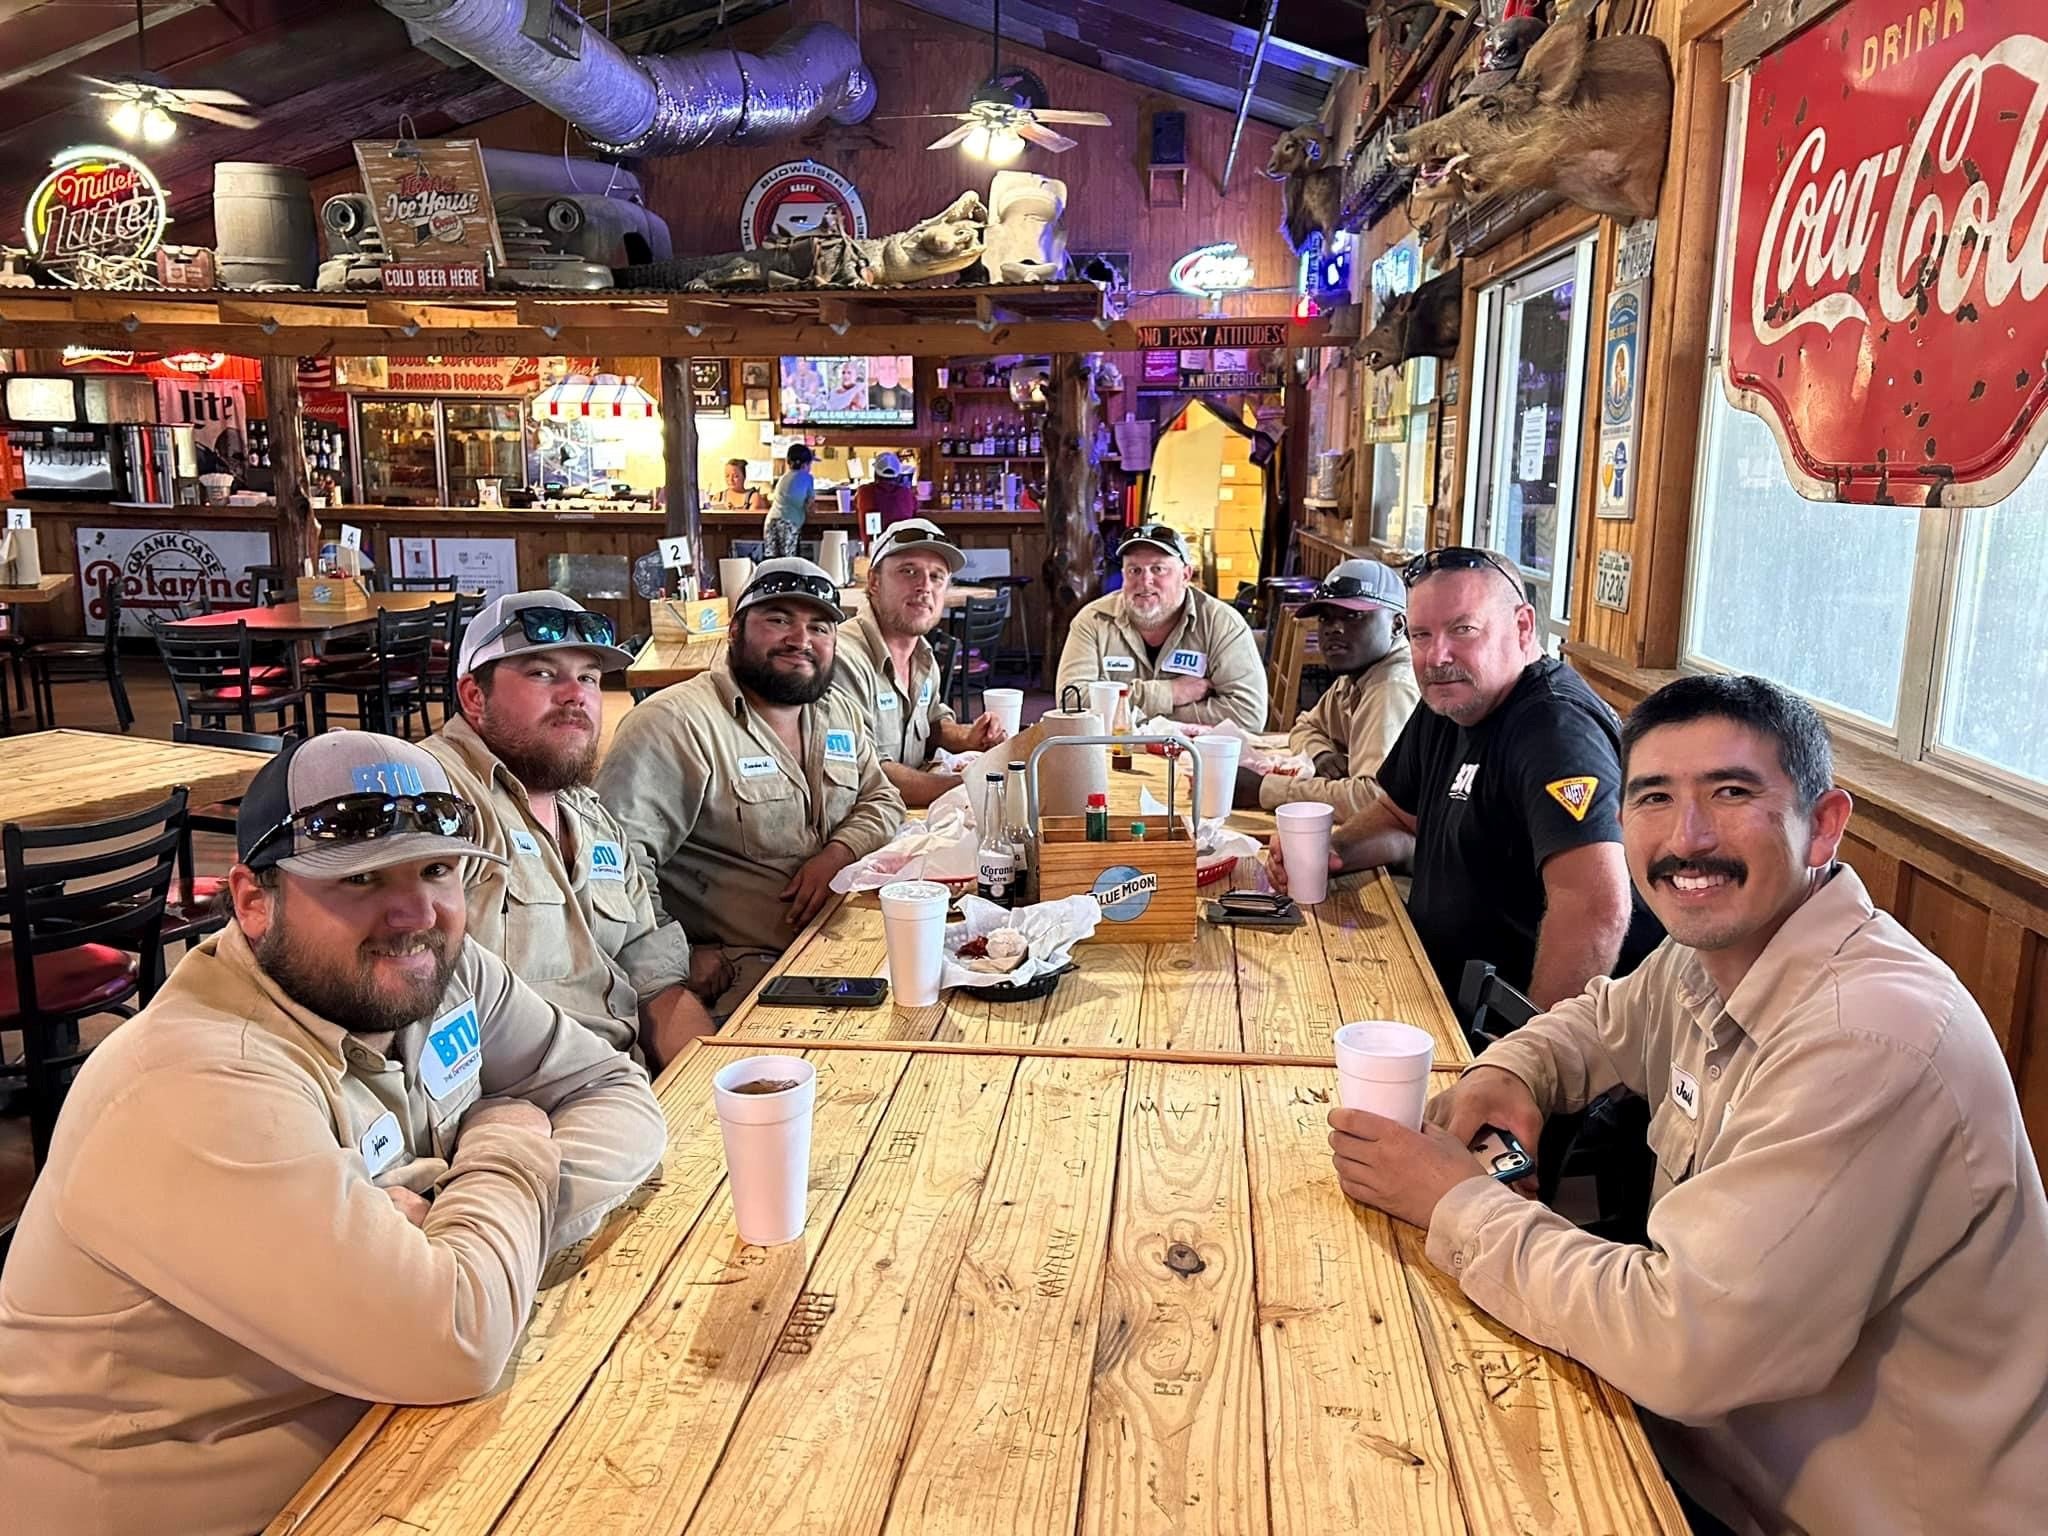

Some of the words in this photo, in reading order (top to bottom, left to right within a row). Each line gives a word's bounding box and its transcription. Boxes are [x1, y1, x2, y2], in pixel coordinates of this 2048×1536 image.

[1860, 0, 1965, 80] DRINK
[759, 164, 845, 190] BUDWEISER
[57, 170, 140, 207] Miller
[384, 269, 415, 288] COLD
[417, 269, 447, 288] BEER
[449, 267, 480, 287] HERE
[1145, 327, 1162, 346] NO
[1169, 327, 1207, 346] PISSY
[1213, 325, 1280, 345] ATTITUDES
[405, 372, 452, 390] ARMED
[453, 373, 504, 391] FORCES
[347, 532, 355, 546] 4
[127, 535, 178, 575] CRANK
[181, 538, 221, 577] CASE
[670, 545, 681, 561] 2
[1173, 652, 1198, 668] BTU
[826, 734, 852, 753] BTU
[352, 762, 425, 796] BTU
[592, 845, 617, 867] BTU
[1121, 875, 1156, 895] MOON
[428, 1010, 480, 1068] BTU
